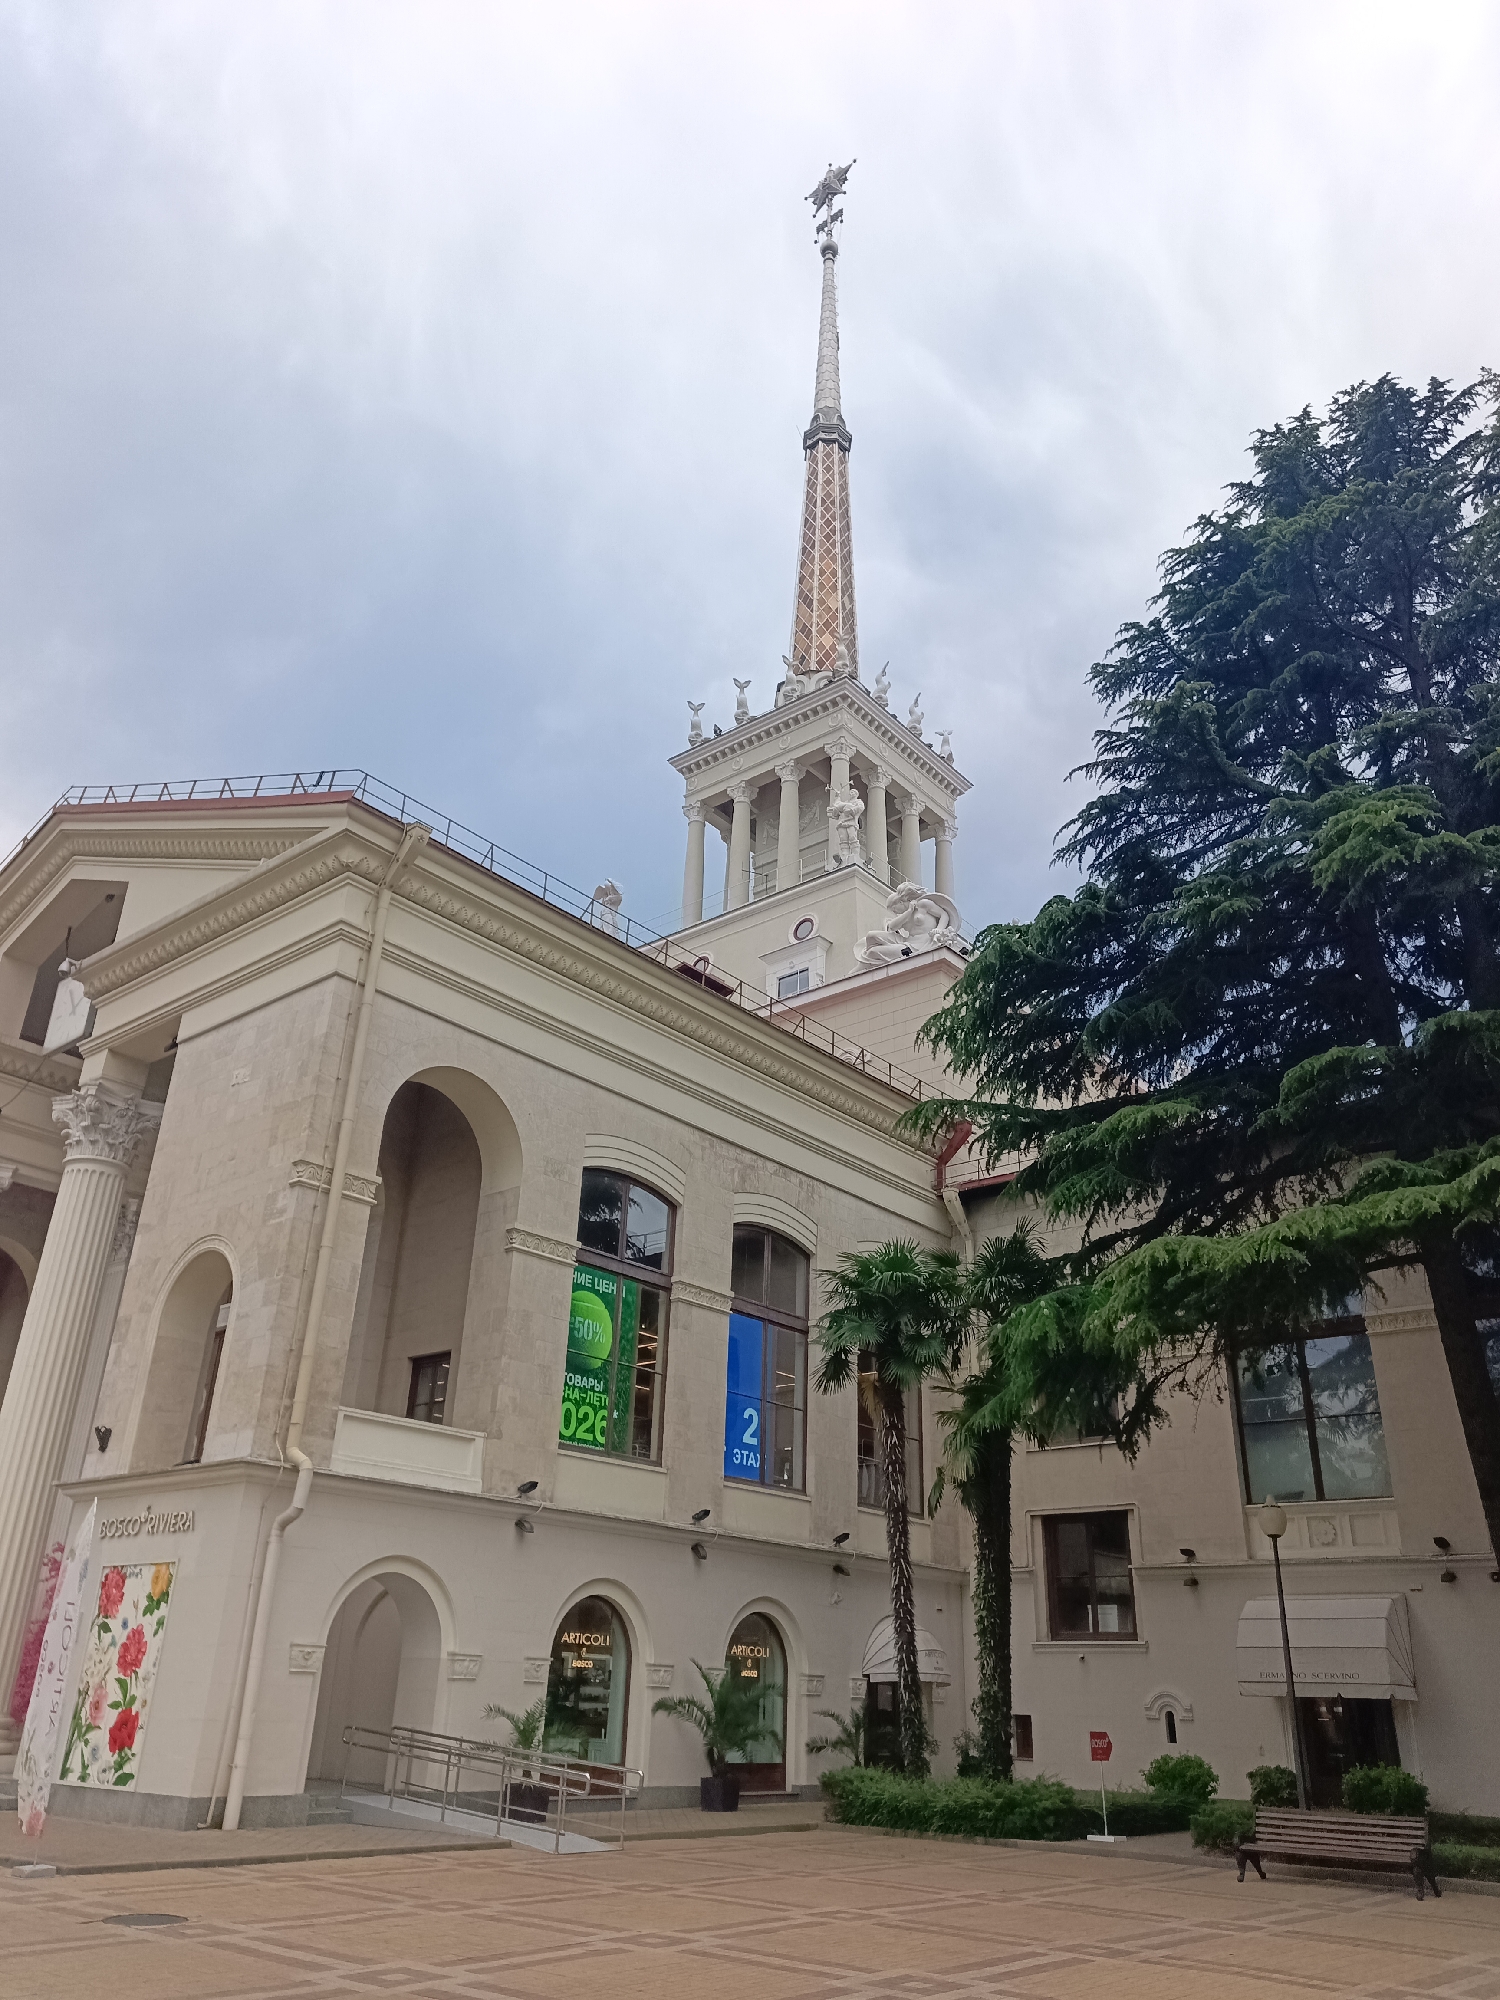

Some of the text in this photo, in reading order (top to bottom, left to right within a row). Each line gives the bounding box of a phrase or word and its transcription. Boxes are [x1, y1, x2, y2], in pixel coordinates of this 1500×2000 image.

[565, 1372, 604, 1392] ОВАРЫ
[562, 1386, 608, 1407] НА-ЛЕТ
[742, 1407, 759, 1446] 2
[99, 1510, 196, 1539] BOSCO RIVIERA
[561, 1632, 610, 1646] ARTICOLI
[731, 1644, 770, 1658] ARTICOLI
[571, 1659, 594, 1668] BOSCO
[1260, 1671, 1360, 1680] ERMANO SCERVINO
